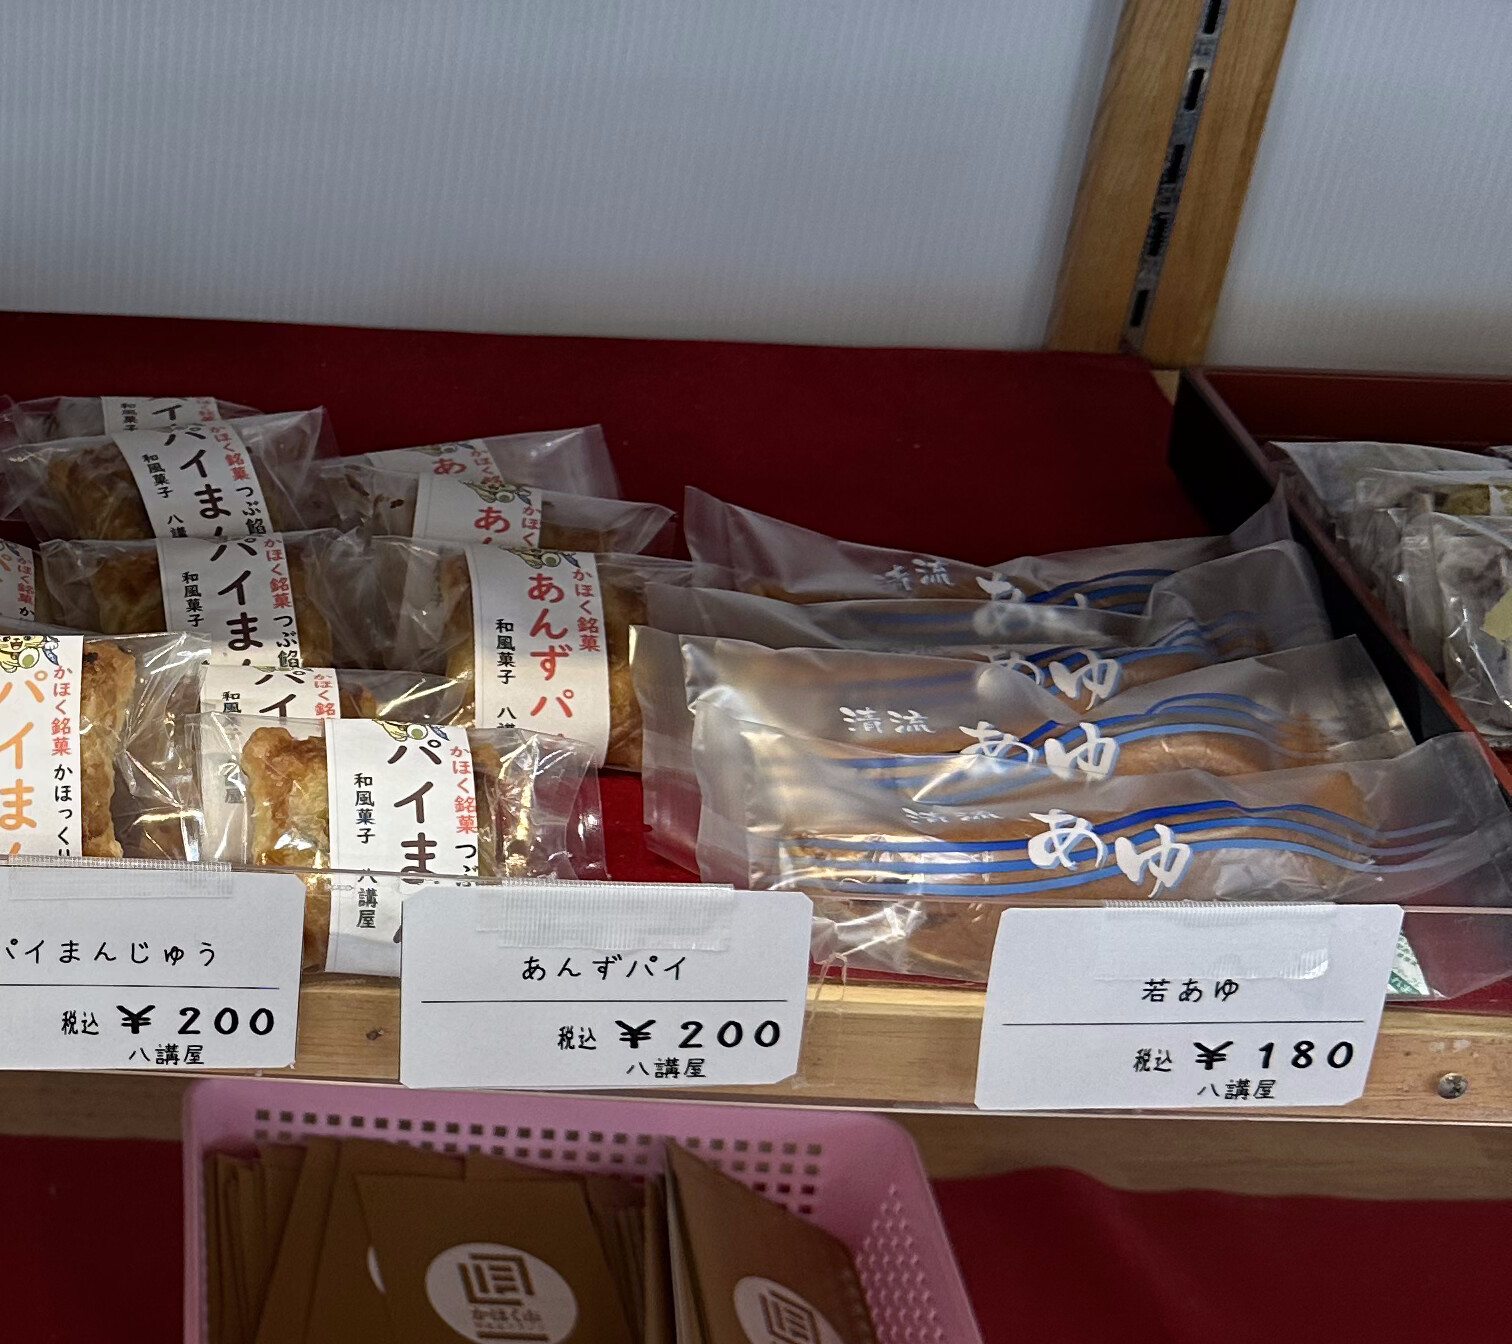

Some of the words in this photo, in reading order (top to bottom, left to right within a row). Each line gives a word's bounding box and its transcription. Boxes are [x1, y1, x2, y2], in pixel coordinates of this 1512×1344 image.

[141, 454, 173, 499] 和風菓子
[210, 426, 250, 481] かほく銘菓
[236, 486, 267, 535] つぶ餡
[474, 506, 511, 545] あ
[181, 571, 205, 628] 和風菓子
[264, 538, 292, 609] かほく銘菓
[209, 537, 264, 666] パイま
[572, 568, 602, 653] かほく銘菓
[273, 615, 302, 669] つぶ餡
[495, 618, 517, 685] 和風菓子
[528, 573, 573, 738] あんずパ
[50, 665, 73, 757] かほく銘菓
[313, 674, 336, 720] かほく銘
[839, 706, 936, 734] 清流
[353, 772, 376, 844] 和風菓子
[449, 745, 479, 835] かほく銘菓
[387, 739, 443, 943] パイま
[1028, 809, 1193, 899] あゆ
[355, 868, 379, 930] 八講屋
[522, 954, 687, 982] あんずパイ
[1141, 978, 1240, 1004] 若あゆ
[61, 1010, 100, 1037] 税込
[115, 1004, 276, 1037] ¥200
[557, 1025, 598, 1051] 税込
[614, 1019, 782, 1049] ¥200
[127, 1044, 205, 1066] 八講屋
[626, 1057, 707, 1080] 八講屋
[1132, 1047, 1174, 1073] 税込
[1193, 1039, 1355, 1071] ¥180
[1197, 1078, 1277, 1100] 八講屋
